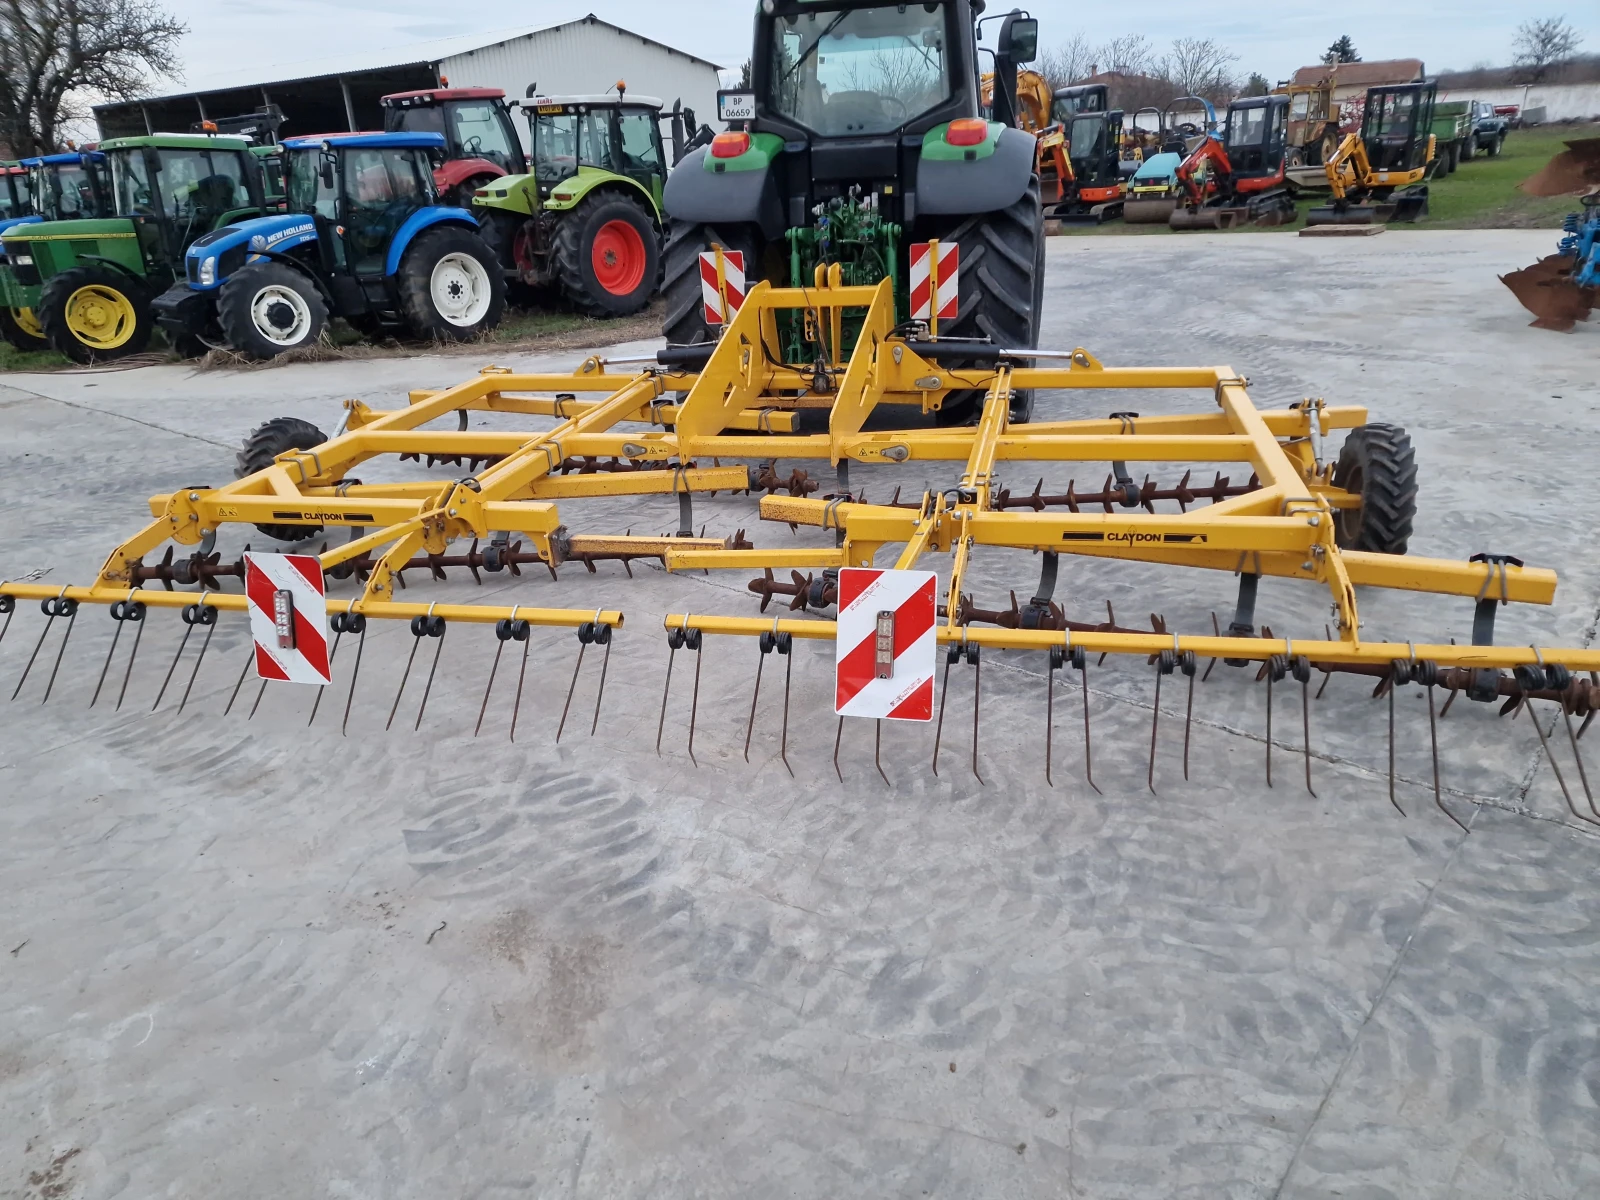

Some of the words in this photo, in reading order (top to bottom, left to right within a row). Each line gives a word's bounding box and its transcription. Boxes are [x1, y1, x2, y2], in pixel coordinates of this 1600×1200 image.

[733, 97, 743, 106] BP
[725, 109, 751, 118] 06659
[267, 231, 283, 243] NEW
[283, 223, 314, 237] HOLLAND
[304, 512, 343, 523] CLAYDON
[1107, 532, 1162, 546] CLAYDON
